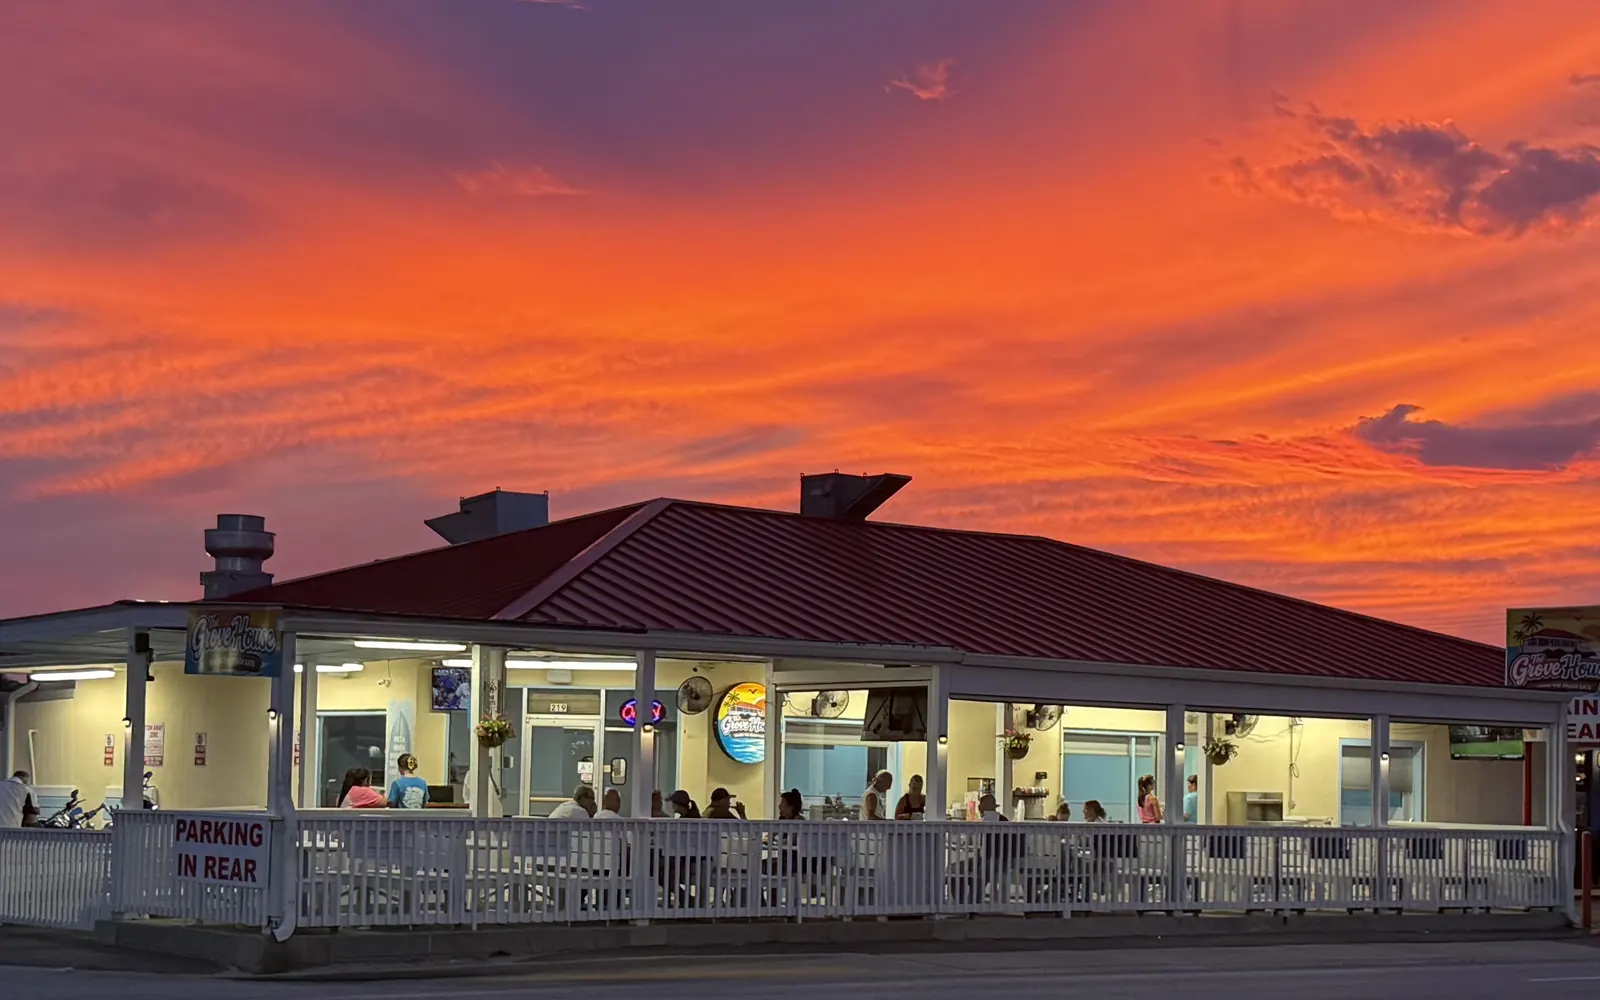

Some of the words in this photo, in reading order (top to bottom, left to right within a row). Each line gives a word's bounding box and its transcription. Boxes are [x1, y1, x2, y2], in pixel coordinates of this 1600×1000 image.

[191, 615, 233, 661] Grove
[230, 614, 277, 654] House
[1510, 654, 1561, 687] Grove
[1559, 653, 1600, 681] Hou
[721, 716, 751, 736] Grove
[175, 818, 263, 848] PARKING
[177, 853, 197, 878] IN
[204, 855, 257, 883] REAR
